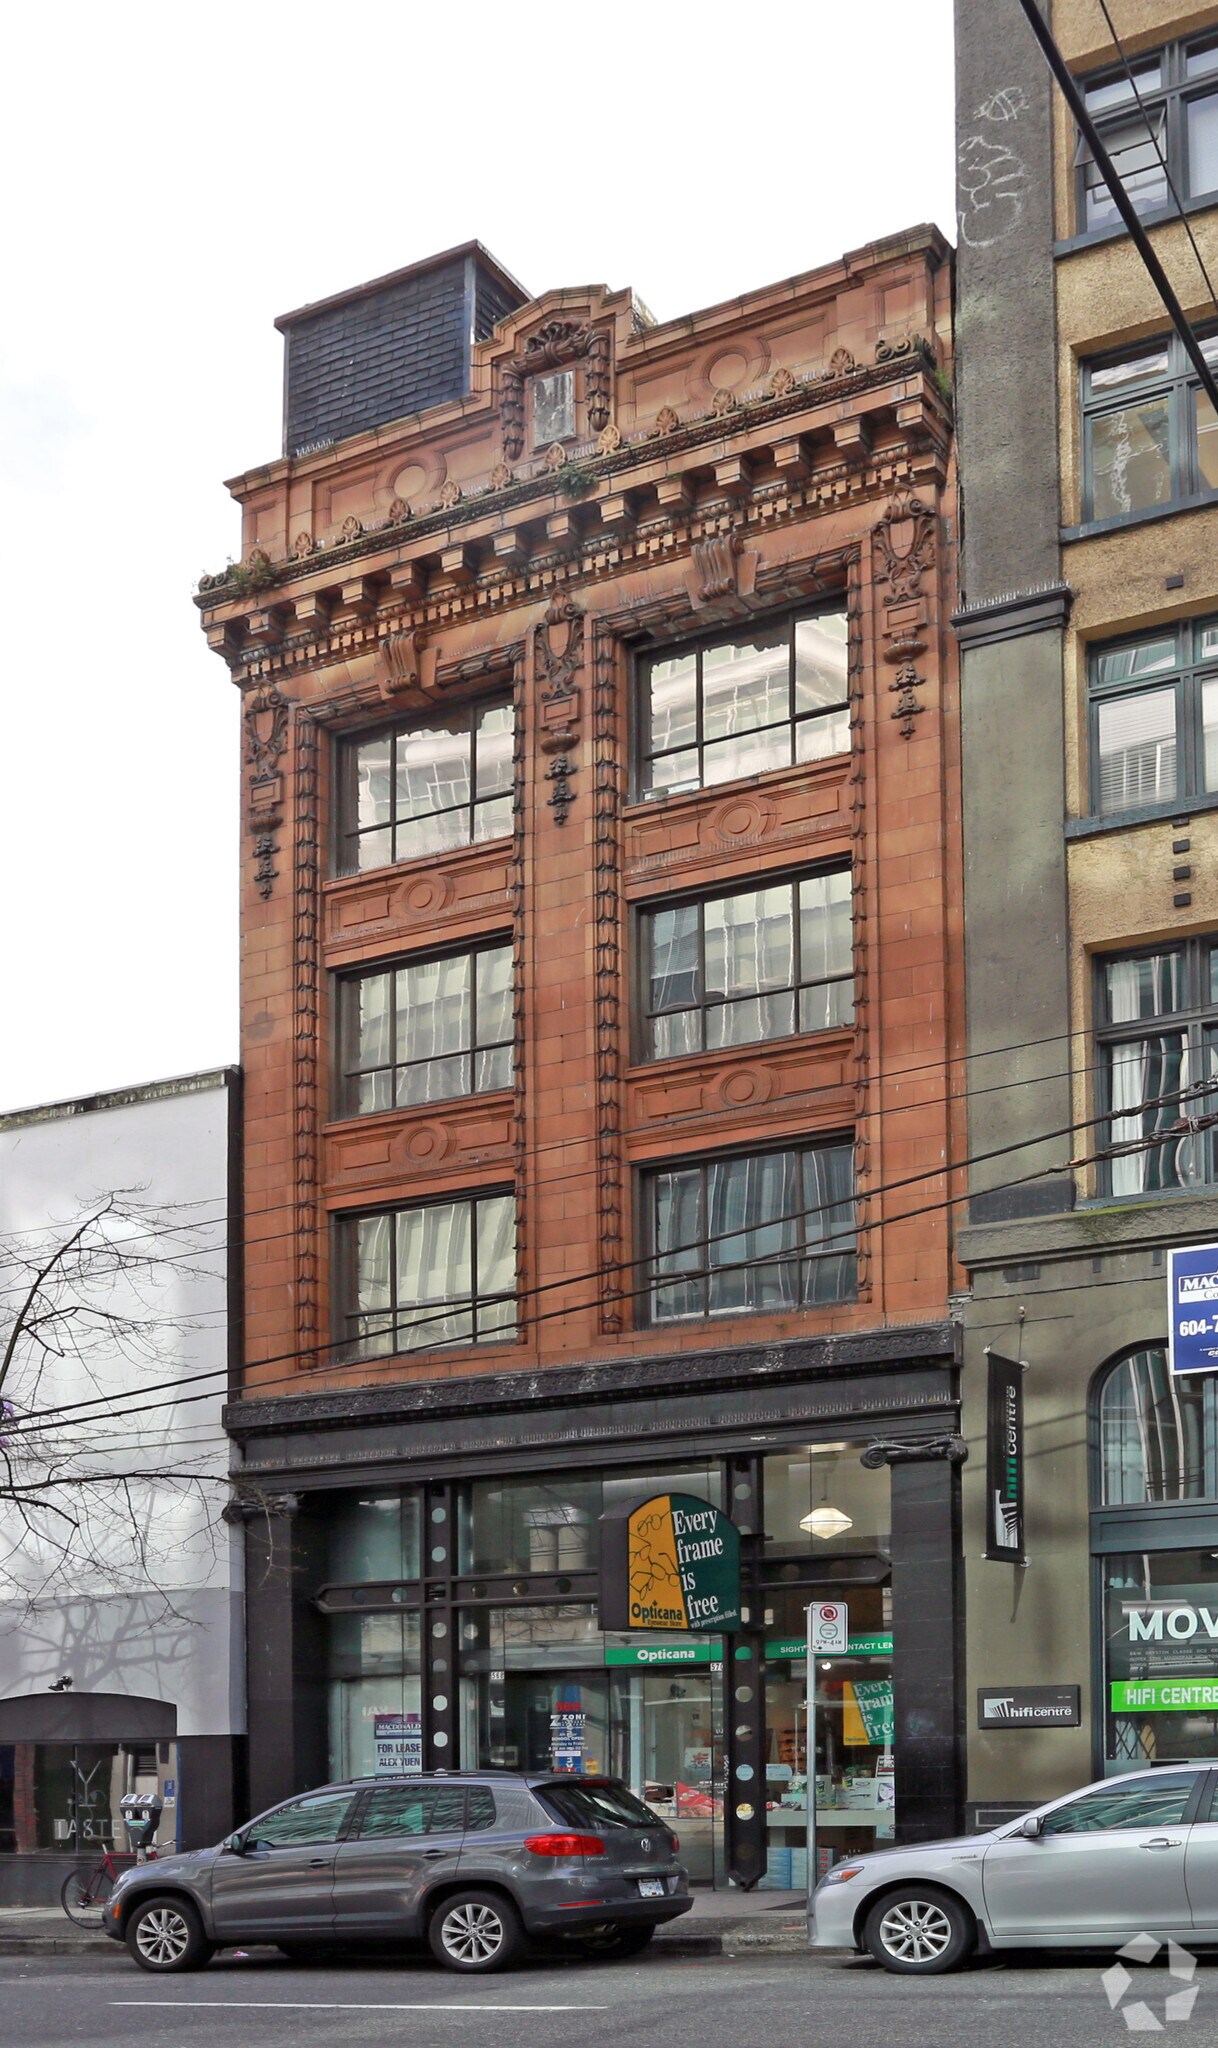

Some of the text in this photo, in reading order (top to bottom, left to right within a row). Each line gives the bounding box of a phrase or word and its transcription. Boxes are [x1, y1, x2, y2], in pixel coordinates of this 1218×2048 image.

[671, 1509, 718, 1536] Every
[676, 1537, 724, 1565] frame
[681, 1566, 696, 1592] is
[631, 1601, 683, 1623] Opticana
[686, 1594, 719, 1620] free
[637, 1648, 696, 1662] Opticana
[780, 1646, 805, 1654] SIGHT
[853, 1679, 893, 1697] Every
[1127, 1686, 1218, 1706] HIFI CENTRE
[862, 1712, 874, 1722] is
[865, 1721, 894, 1740] fre
[377, 1743, 421, 1753] FOR LEASE
[379, 1757, 420, 1767] ALEX YUEN
